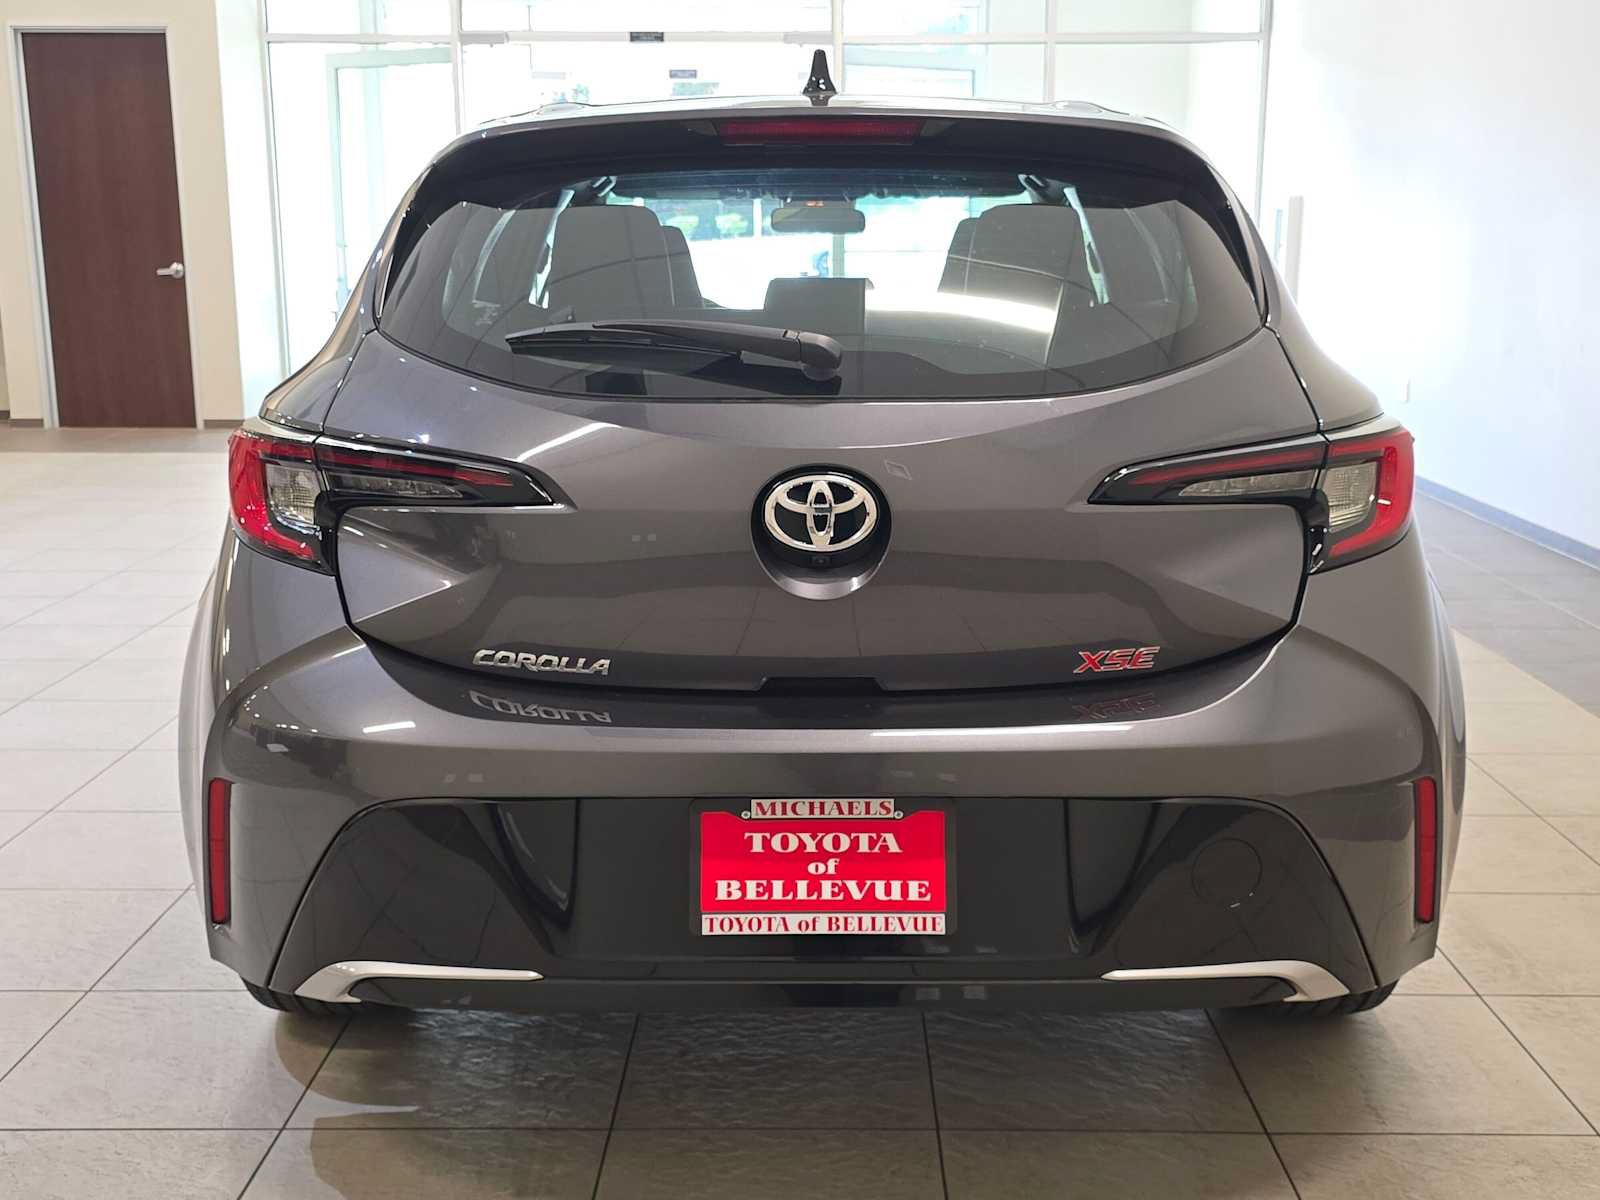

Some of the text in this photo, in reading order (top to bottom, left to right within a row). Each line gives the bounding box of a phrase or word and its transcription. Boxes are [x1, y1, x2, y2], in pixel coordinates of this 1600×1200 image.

[472, 649, 611, 675] COROLLA
[1072, 646, 1160, 673] XSE
[754, 801, 892, 816] MICHAELS
[744, 832, 903, 853] TOYOTA
[807, 858, 840, 875] of
[714, 879, 932, 901] BELLEVUE
[705, 916, 943, 933] TOYOTA of BELLEVUE
